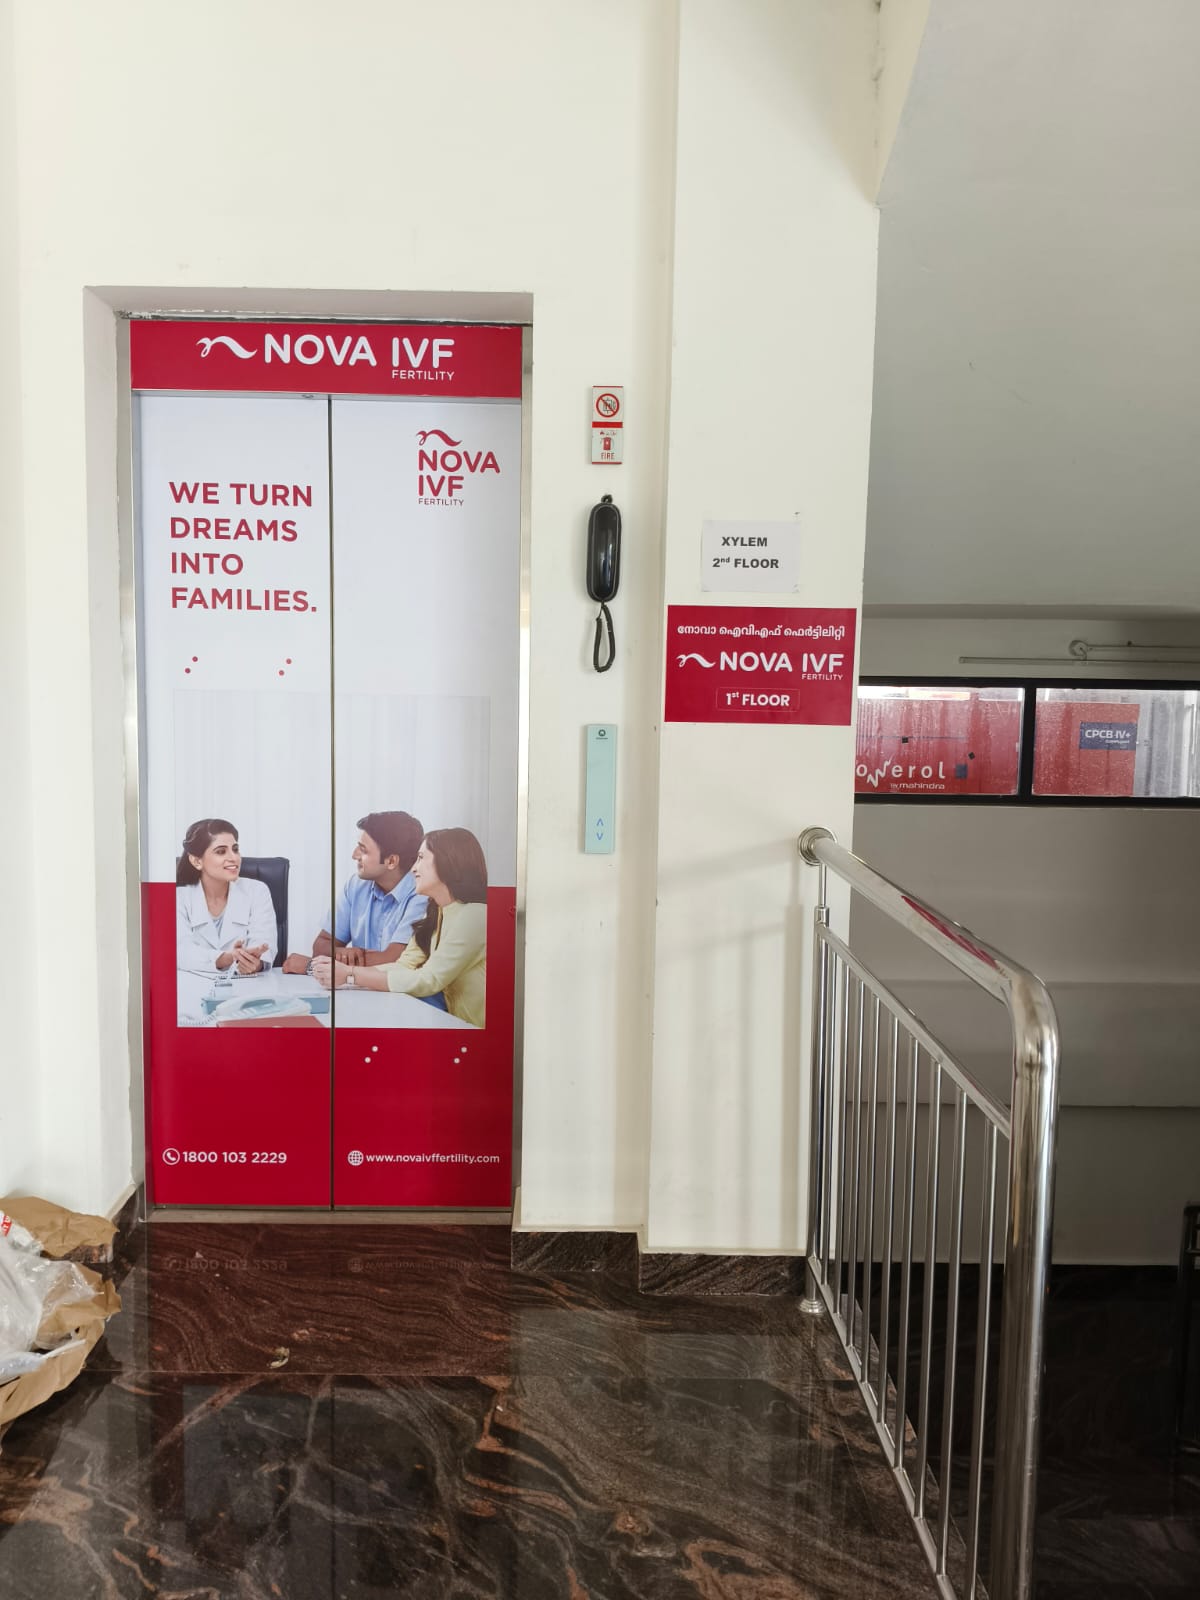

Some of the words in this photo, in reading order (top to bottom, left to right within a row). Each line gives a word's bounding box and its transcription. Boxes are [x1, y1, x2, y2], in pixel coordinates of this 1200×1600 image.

[263, 333, 378, 367] NOVA
[391, 337, 455, 369] IVF
[391, 369, 455, 381] FERTILITY
[418, 449, 501, 473] NOVA
[601, 452, 615, 460] FIRE
[168, 481, 220, 505] WE
[229, 483, 312, 507] TURN
[418, 474, 465, 498] IVF
[418, 498, 465, 507] FERTILITY
[170, 517, 299, 542] DREAMS
[721, 536, 768, 547] XYLEM
[171, 552, 244, 575] INTO
[712, 556, 731, 568] 2nd
[733, 558, 780, 569] FLOOR
[171, 587, 317, 613] FAMILIES.
[719, 651, 793, 672] NOVA
[802, 652, 845, 673] IVF
[801, 673, 844, 681] FERTILITY
[726, 691, 740, 706] 1st
[742, 693, 791, 707] FLOOR
[855, 758, 946, 788] owerol
[182, 1151, 218, 1164] 1800
[222, 1151, 247, 1164] 103
[251, 1151, 288, 1165] 2229
[365, 1152, 500, 1166] www.novaivffertility.com
